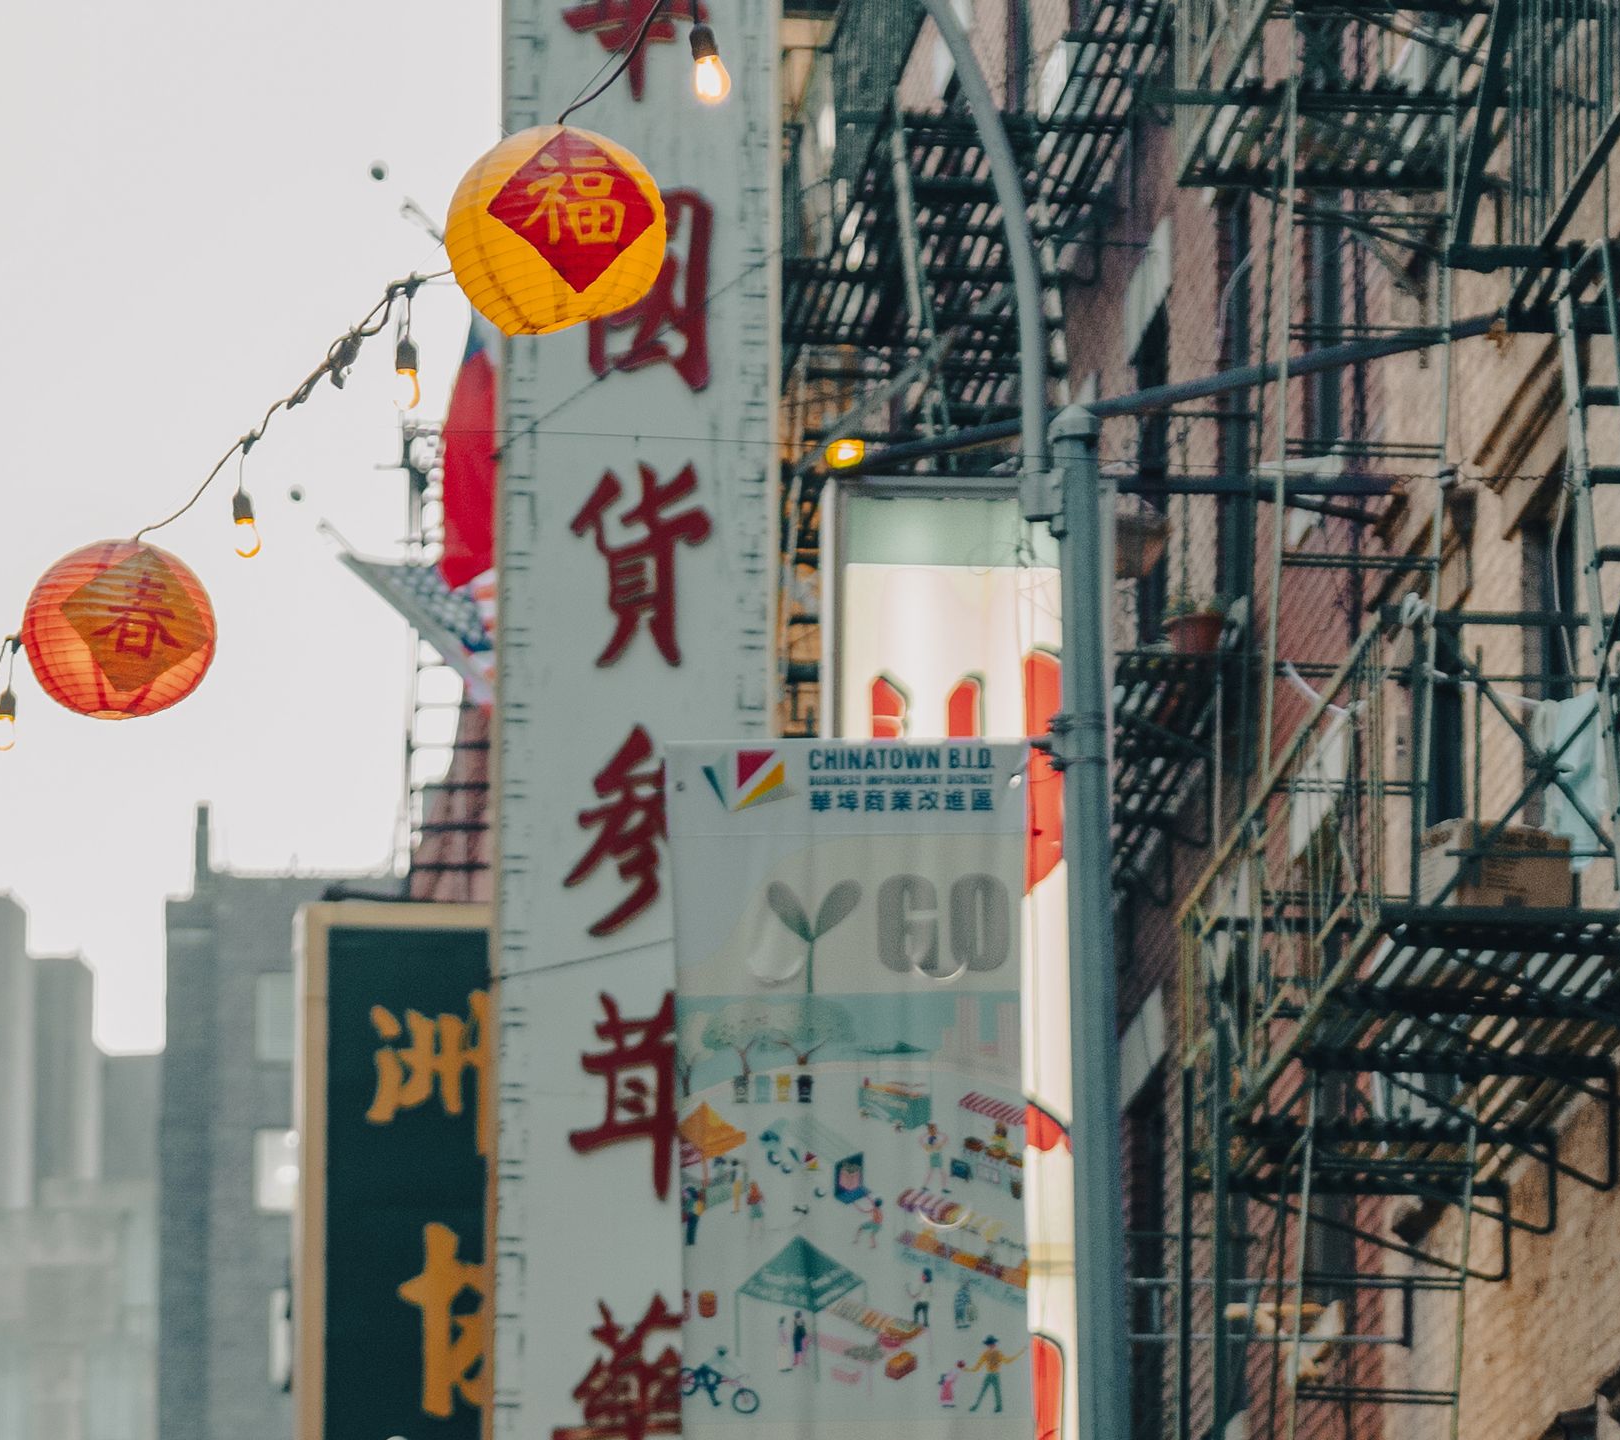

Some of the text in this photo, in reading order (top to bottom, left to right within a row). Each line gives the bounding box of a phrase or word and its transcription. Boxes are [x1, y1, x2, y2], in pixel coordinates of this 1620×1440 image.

[522, 153, 627, 246] 福
[93, 574, 182, 661] 春
[808, 747, 995, 771] CHINATOWN B.I.D.
[809, 773, 993, 786] BUSINESS IMPROVEMENT DISTRICT
[809, 788, 994, 812] 華埠商業改進區
[876, 873, 1011, 974] GO
